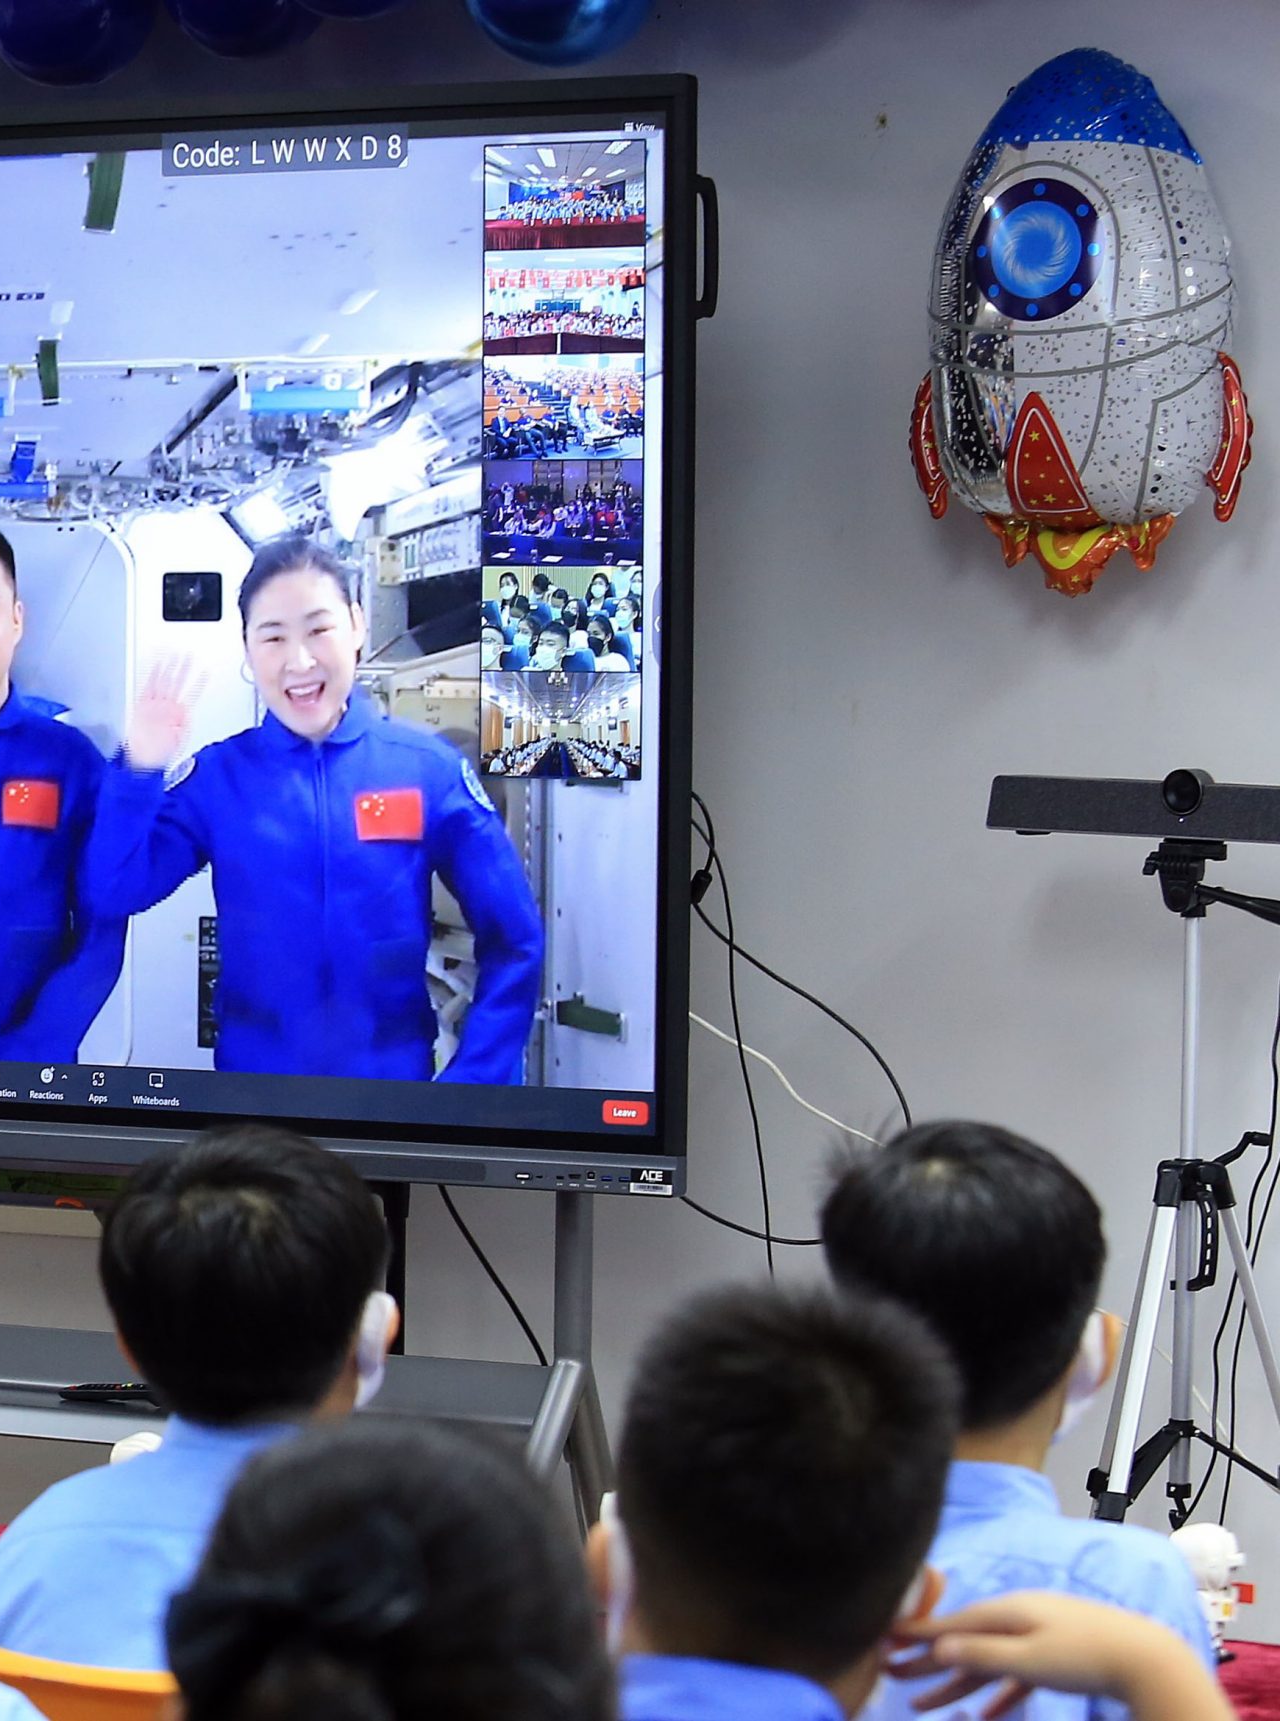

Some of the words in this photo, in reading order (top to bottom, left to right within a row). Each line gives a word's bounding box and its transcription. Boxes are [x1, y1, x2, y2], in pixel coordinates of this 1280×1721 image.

[635, 122, 656, 132] View
[172, 140, 241, 168] Code:
[251, 140, 266, 165] L
[272, 138, 296, 164] W
[303, 137, 327, 163] W
[335, 136, 352, 162] X
[361, 135, 378, 161] D
[387, 134, 403, 160] 8
[29, 1089, 64, 1101] Reactions
[88, 1092, 108, 1105] Apps
[132, 1094, 180, 1107] Whiteboards
[612, 1107, 637, 1119] Leave
[639, 1169, 664, 1183] ACE
